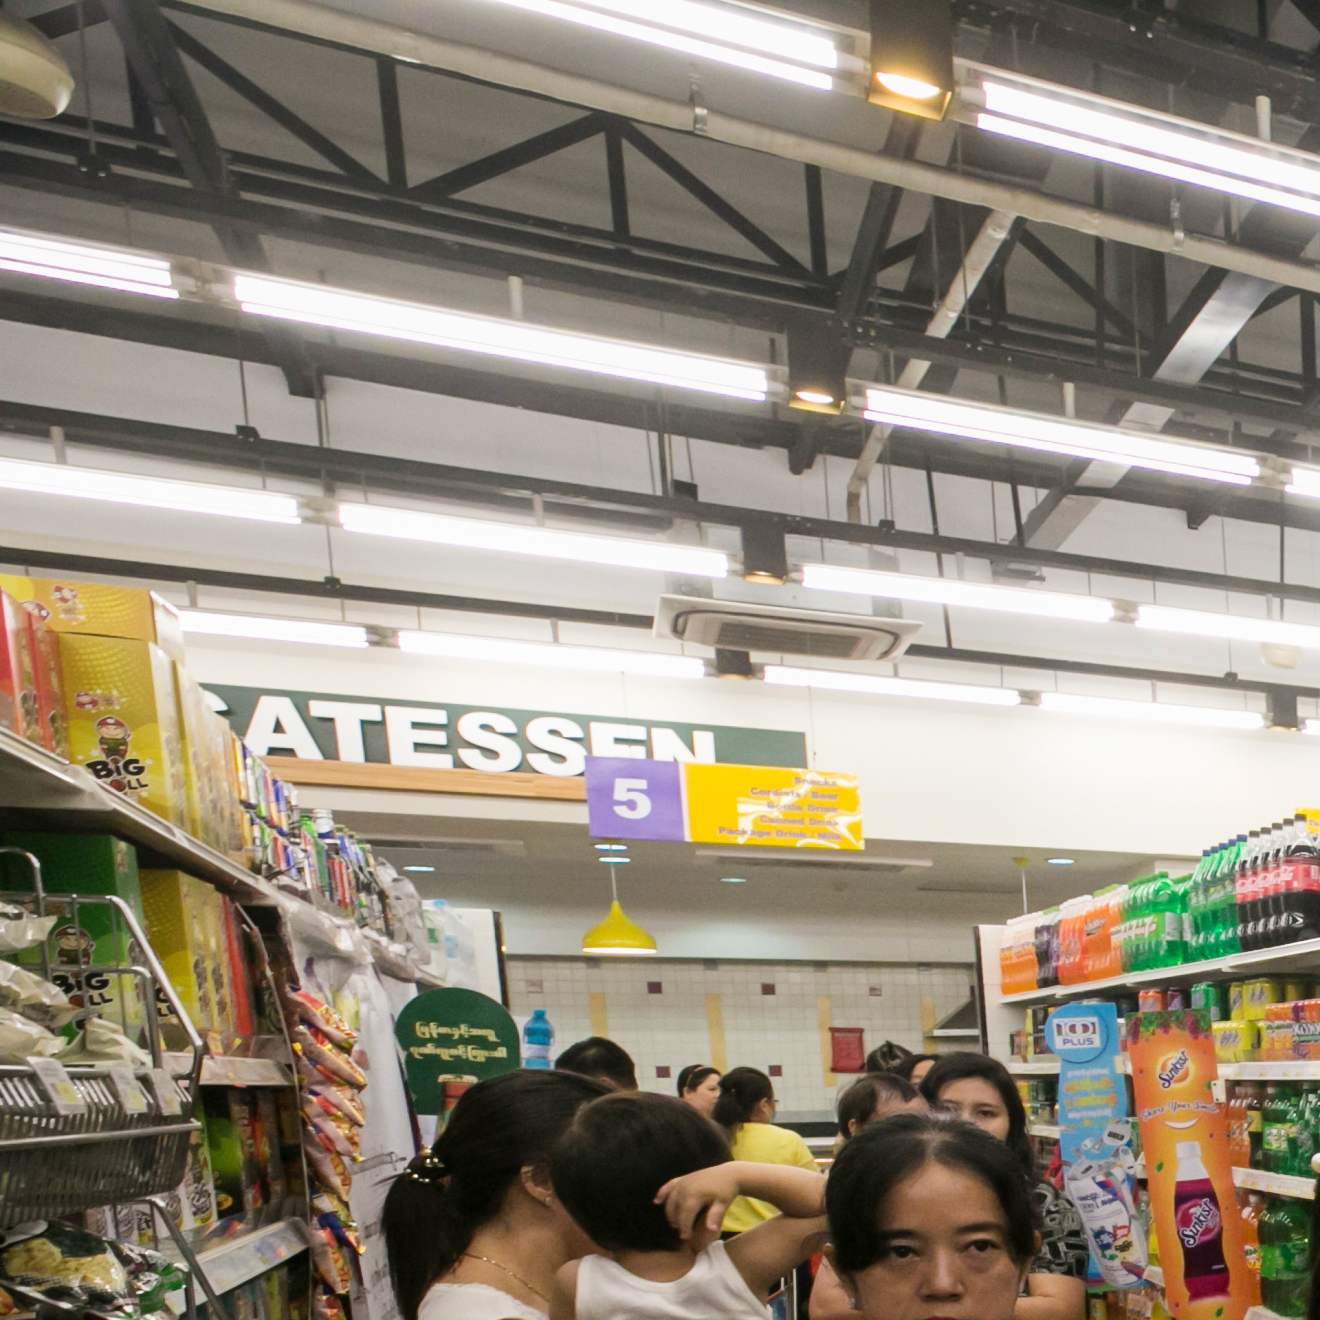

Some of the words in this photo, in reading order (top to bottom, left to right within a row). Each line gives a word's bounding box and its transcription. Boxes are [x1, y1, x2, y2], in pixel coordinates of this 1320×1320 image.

[612, 777, 652, 820] 5
[1062, 1036, 1095, 1047] PLUS
[1180, 1198, 1212, 1249] Sunkist
